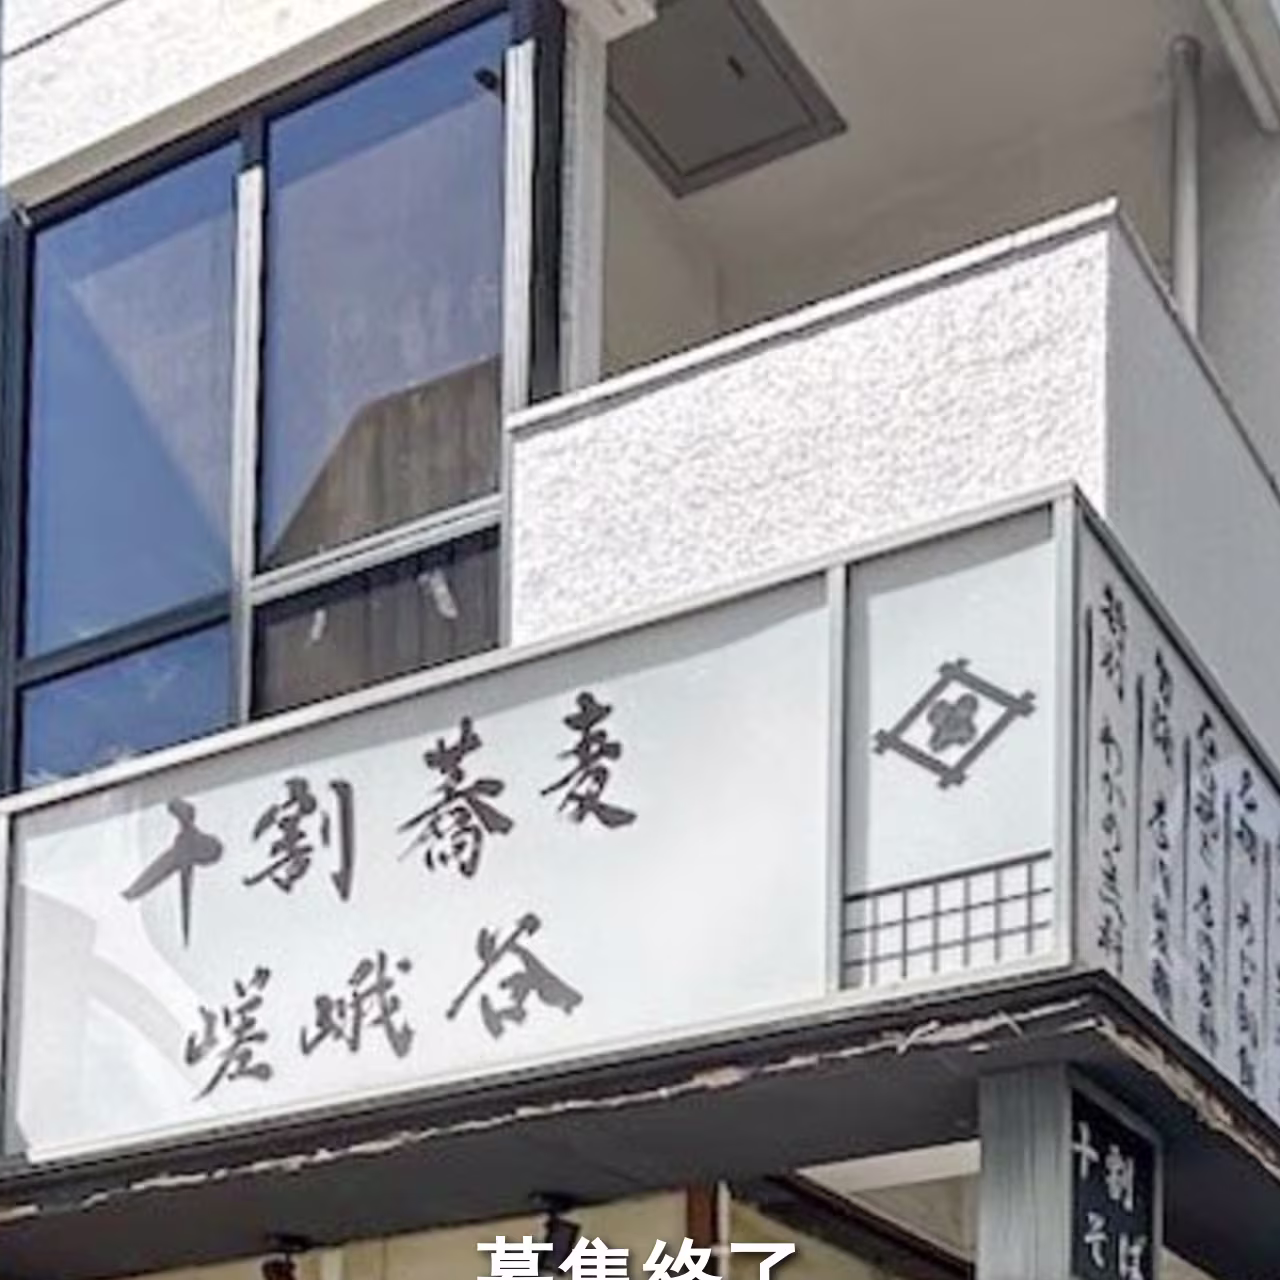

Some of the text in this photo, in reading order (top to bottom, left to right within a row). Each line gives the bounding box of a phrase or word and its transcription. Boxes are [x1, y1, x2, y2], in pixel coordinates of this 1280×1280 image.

[122, 691, 638, 946] 十割蕎麦
[183, 913, 584, 1101] 嵯峨谷
[1073, 1122, 1135, 1211] 十割
